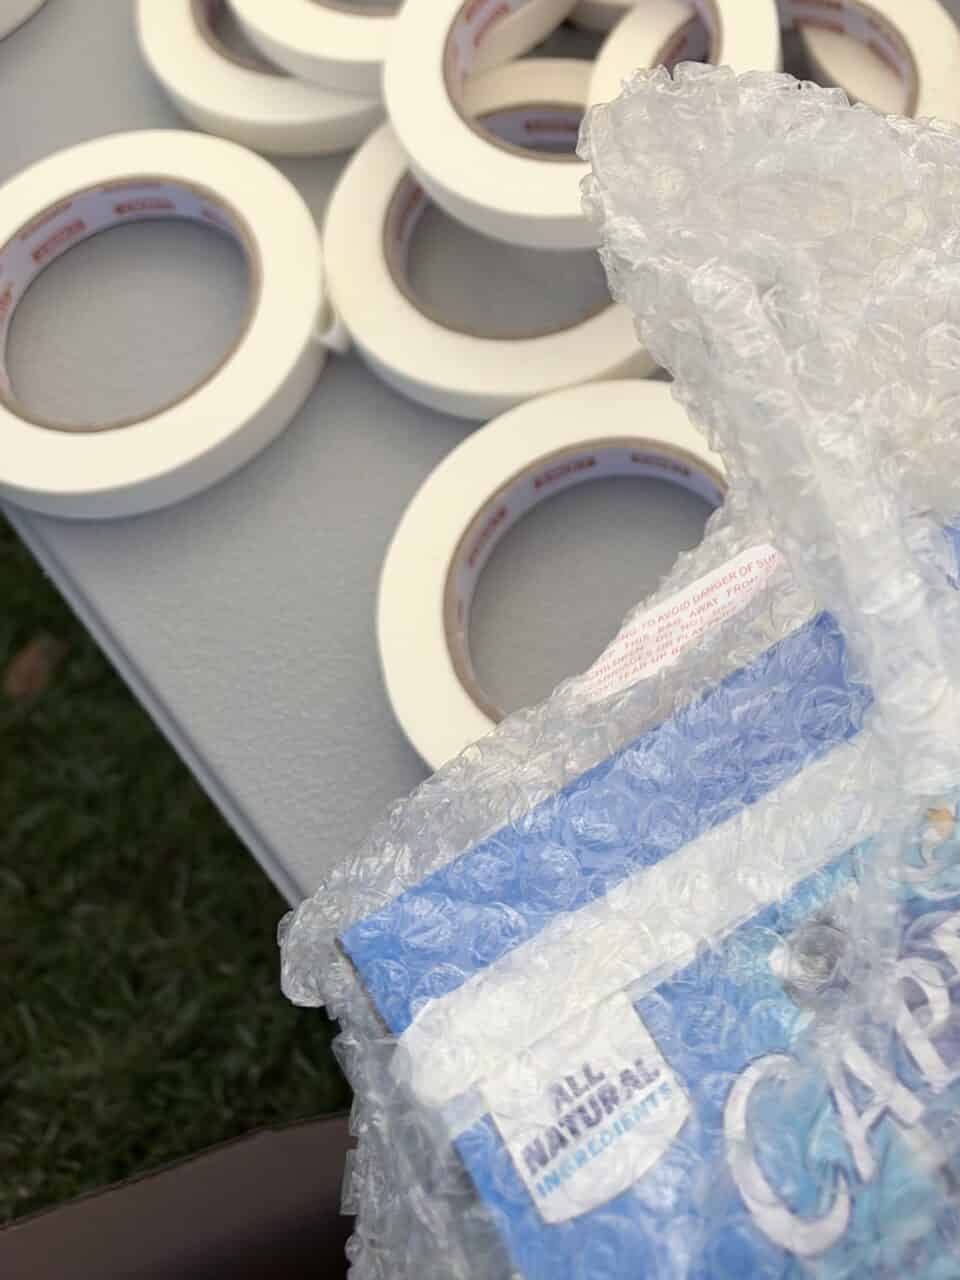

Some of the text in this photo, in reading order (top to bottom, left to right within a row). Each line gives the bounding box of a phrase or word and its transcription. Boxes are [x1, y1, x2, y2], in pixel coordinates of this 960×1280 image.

[657, 598, 691, 625] AVOID
[738, 562, 754, 578] OF
[522, 1057, 661, 1176] NATURAL
[549, 1062, 606, 1111] ALL
